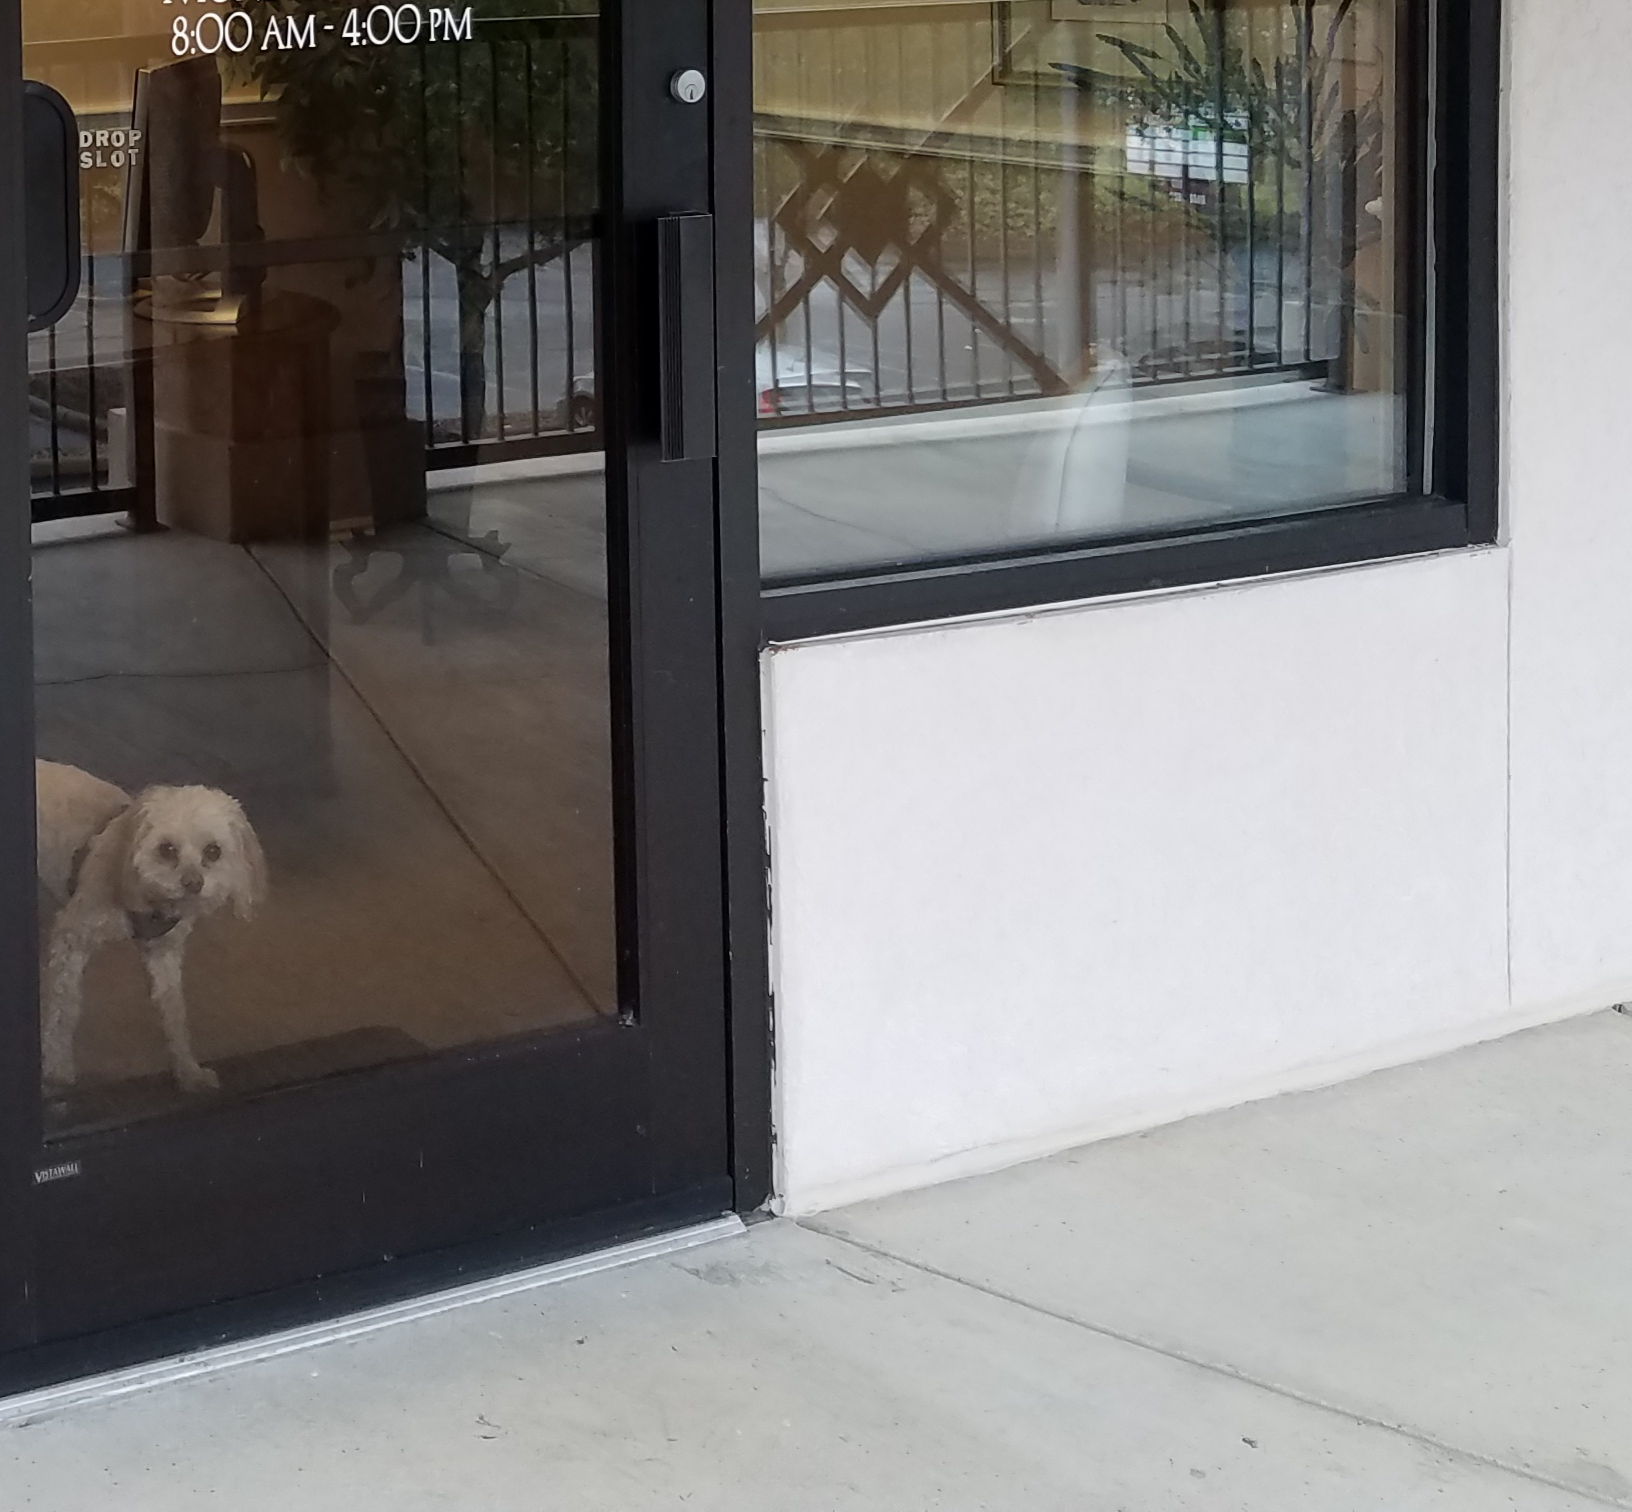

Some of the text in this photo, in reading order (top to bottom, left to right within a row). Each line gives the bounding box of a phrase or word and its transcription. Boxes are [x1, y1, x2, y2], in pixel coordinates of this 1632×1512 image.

[170, 11, 253, 56] 8:00
[261, 14, 316, 51] AM
[341, 3, 422, 47] 4:00
[429, 6, 473, 42] PM
[79, 129, 142, 148] DROP
[79, 148, 139, 169] SLOT
